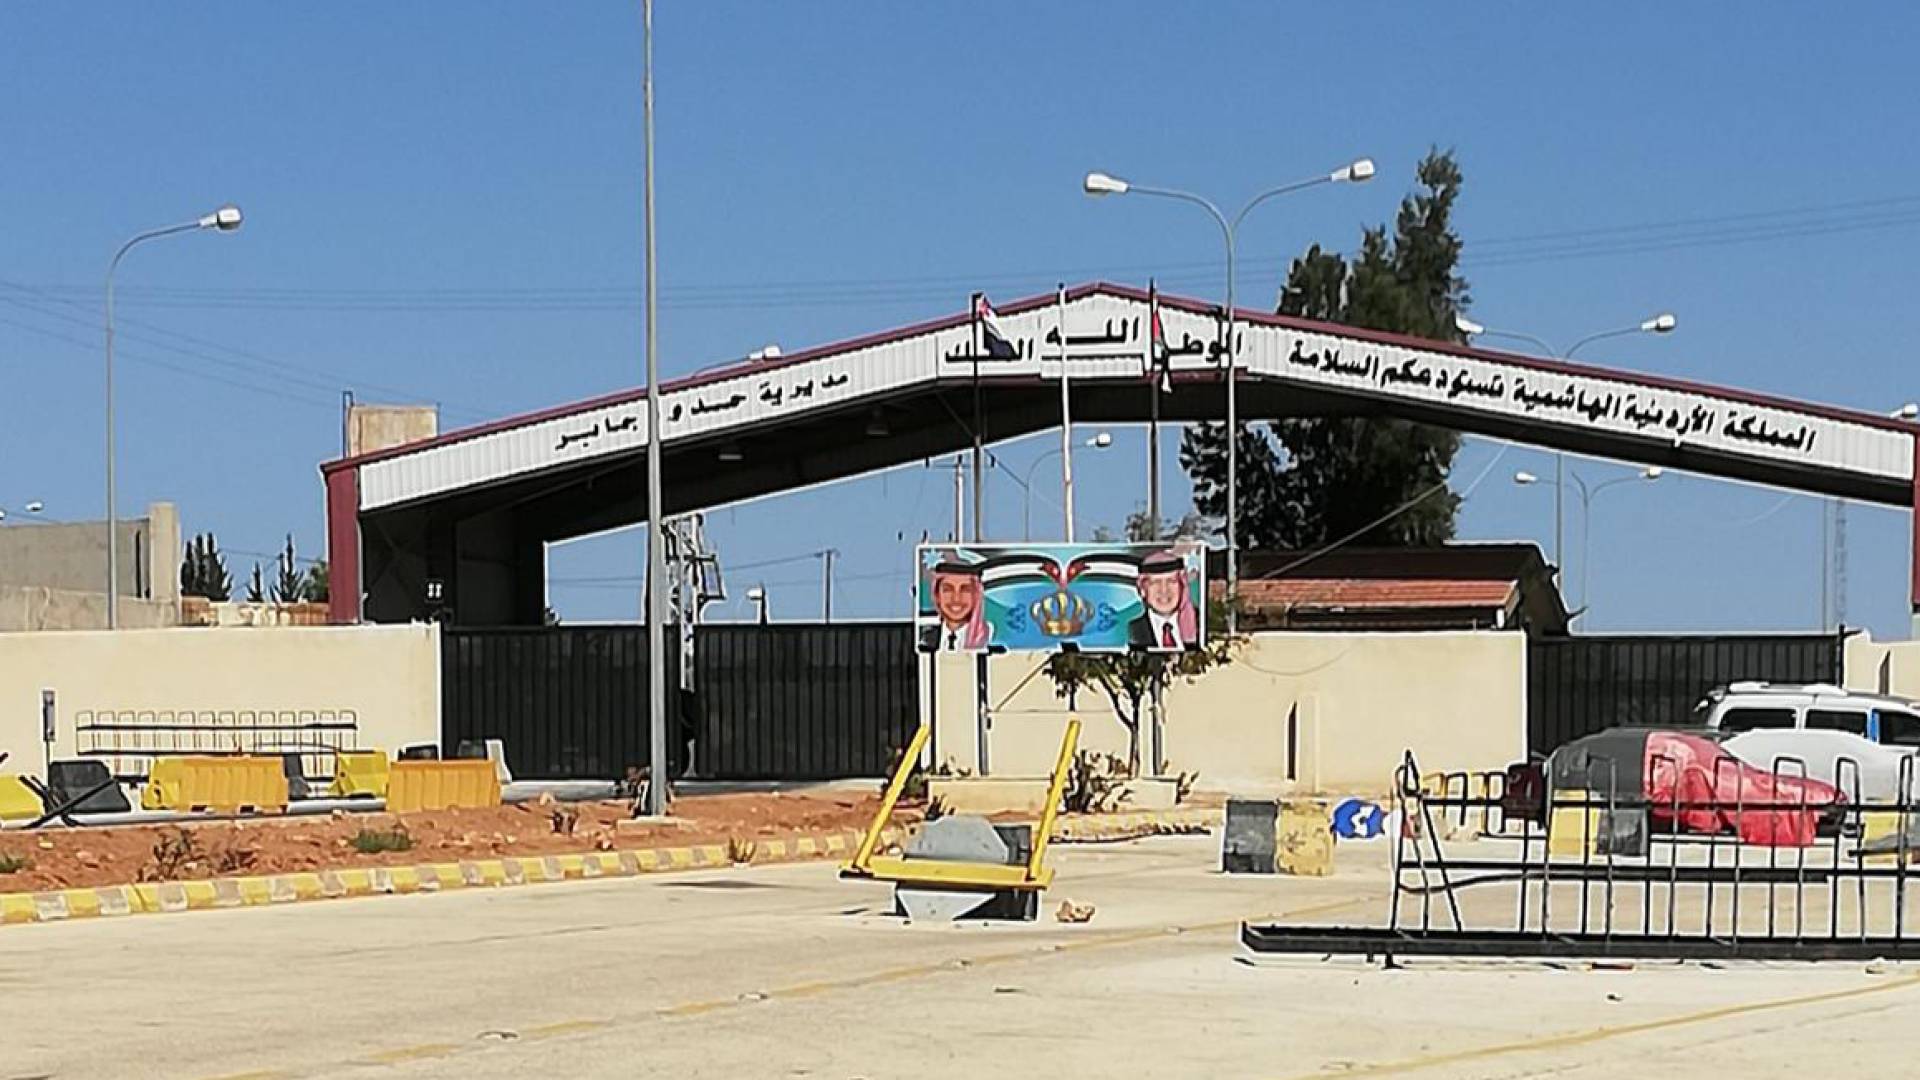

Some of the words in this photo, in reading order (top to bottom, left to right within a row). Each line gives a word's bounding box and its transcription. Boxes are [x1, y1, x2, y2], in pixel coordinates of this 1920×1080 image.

[1045, 316, 1139, 347] الله
[1288, 339, 1379, 382] السلامة
[759, 372, 849, 406] مديرية
[1513, 377, 1621, 420] الهاشمية
[555, 413, 637, 450] جابر
[1624, 393, 1716, 436] الأردنية
[1723, 410, 1817, 453] المملكة
